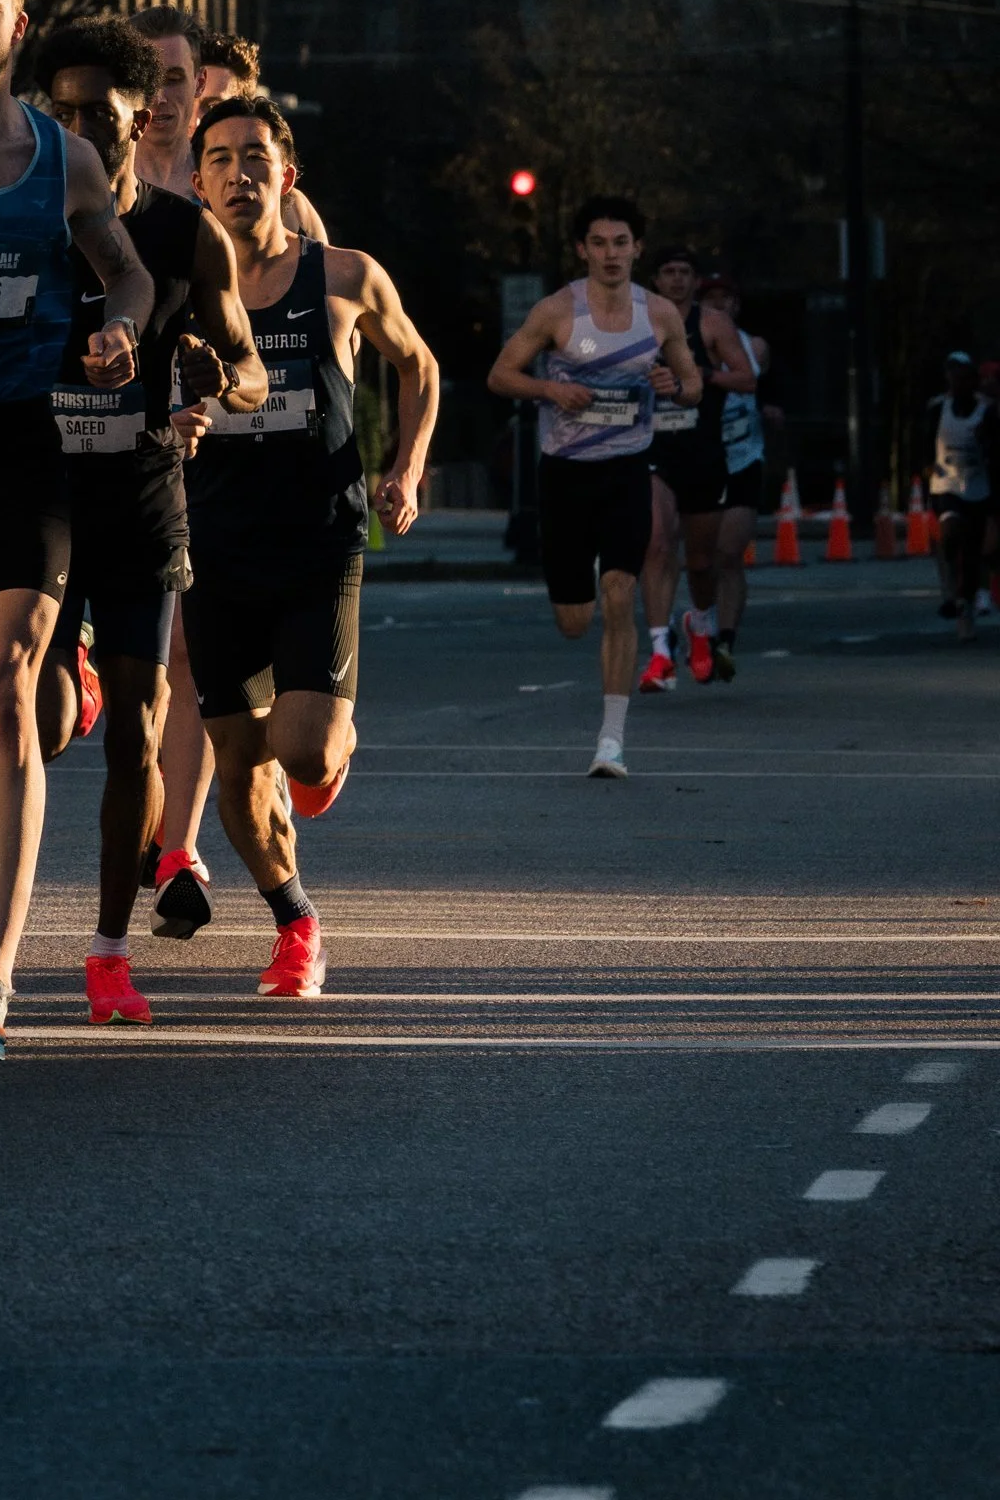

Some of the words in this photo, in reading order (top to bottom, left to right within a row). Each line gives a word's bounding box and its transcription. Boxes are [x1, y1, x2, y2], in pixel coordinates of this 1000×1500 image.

[254, 333, 308, 350] RBIRDS
[66, 421, 105, 435] SAEED
[251, 416, 264, 429] 49
[80, 438, 93, 451] 16
